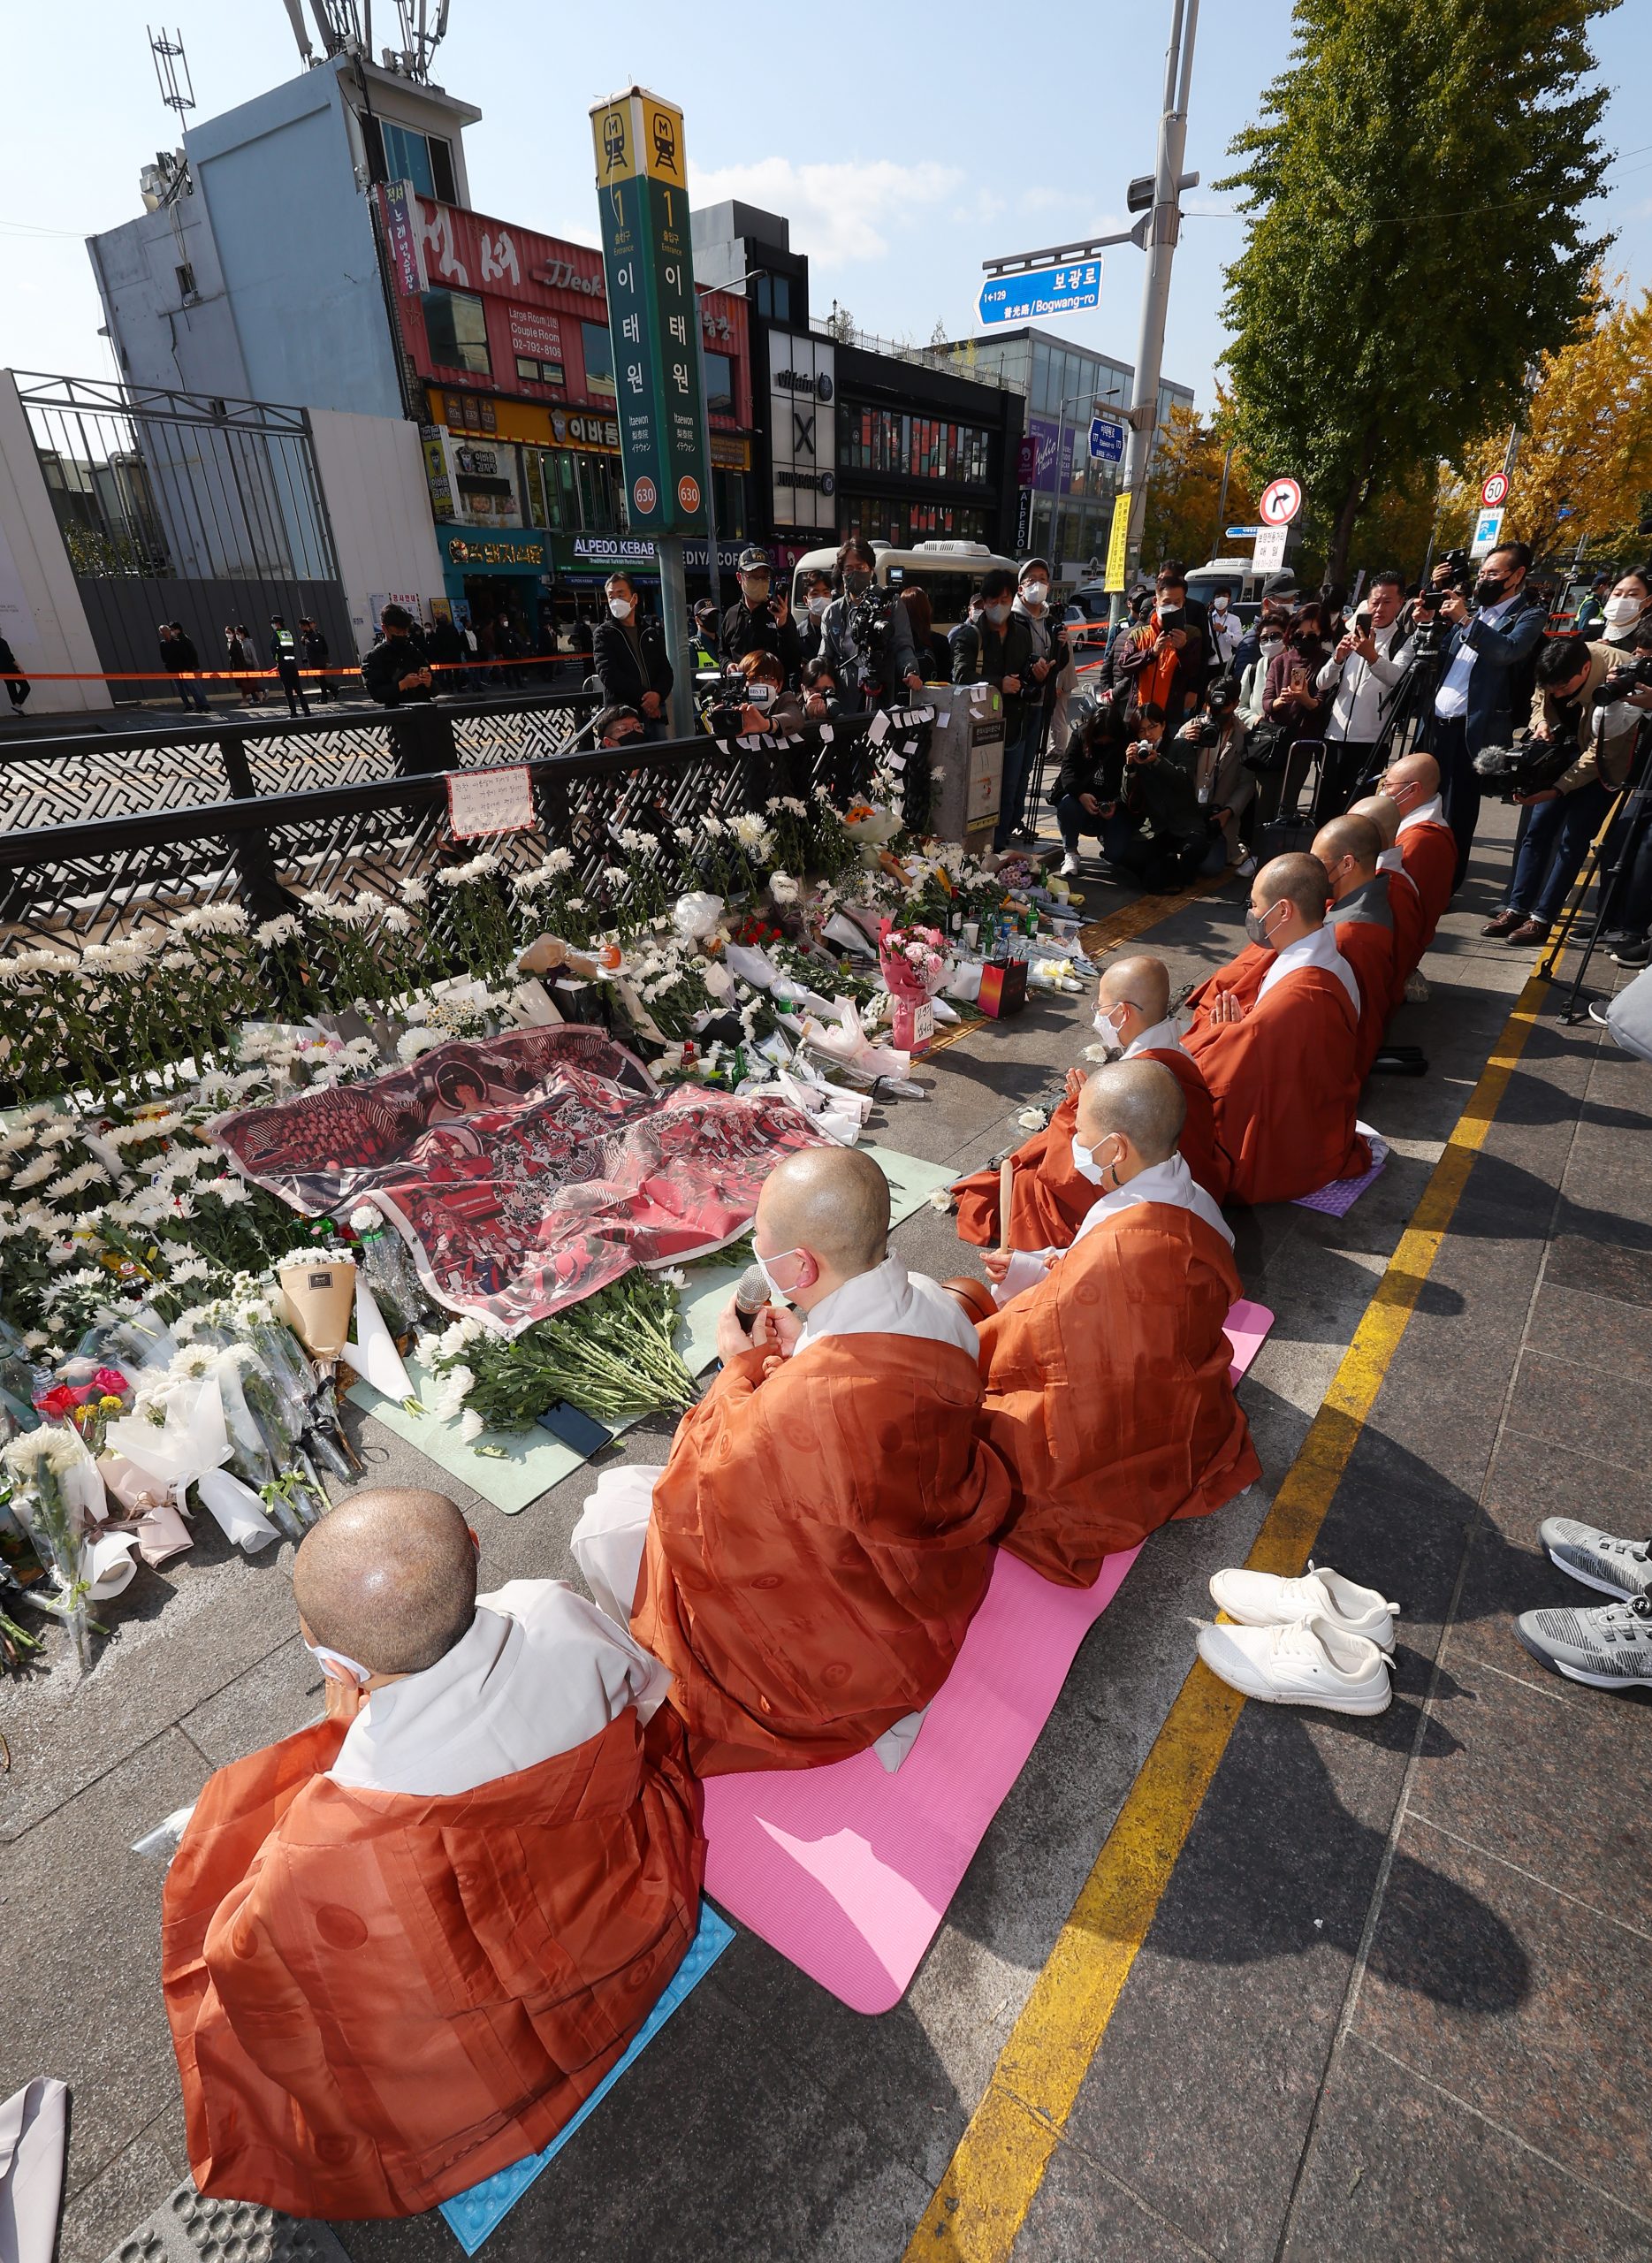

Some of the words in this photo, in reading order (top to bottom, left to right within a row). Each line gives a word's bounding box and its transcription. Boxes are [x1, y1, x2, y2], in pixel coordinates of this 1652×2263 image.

[614, 189, 624, 227] 1
[663, 189, 673, 227] 1
[663, 230, 680, 245] 출입구
[613, 245, 635, 256] Entrance
[661, 244, 682, 257] Entrance
[1053, 267, 1097, 291] 보광로
[508, 307, 528, 323] Large
[527, 311, 546, 325] Room
[511, 322, 537, 338] Couple
[538, 329, 560, 343] Room
[618, 262, 644, 394] 이태원
[665, 264, 689, 395] 이태원
[628, 415, 649, 427] Itaewon
[674, 412, 694, 426] Itaewon
[676, 428, 694, 440] 梨泰院
[794, 413, 815, 454] X
[636, 486, 654, 502] 630
[680, 486, 698, 502] 630
[1488, 482, 1502, 499] 50
[1016, 491, 1028, 548] ALPEDO
[575, 538, 618, 554] ALPEDO
[620, 540, 655, 555] KEBAB
